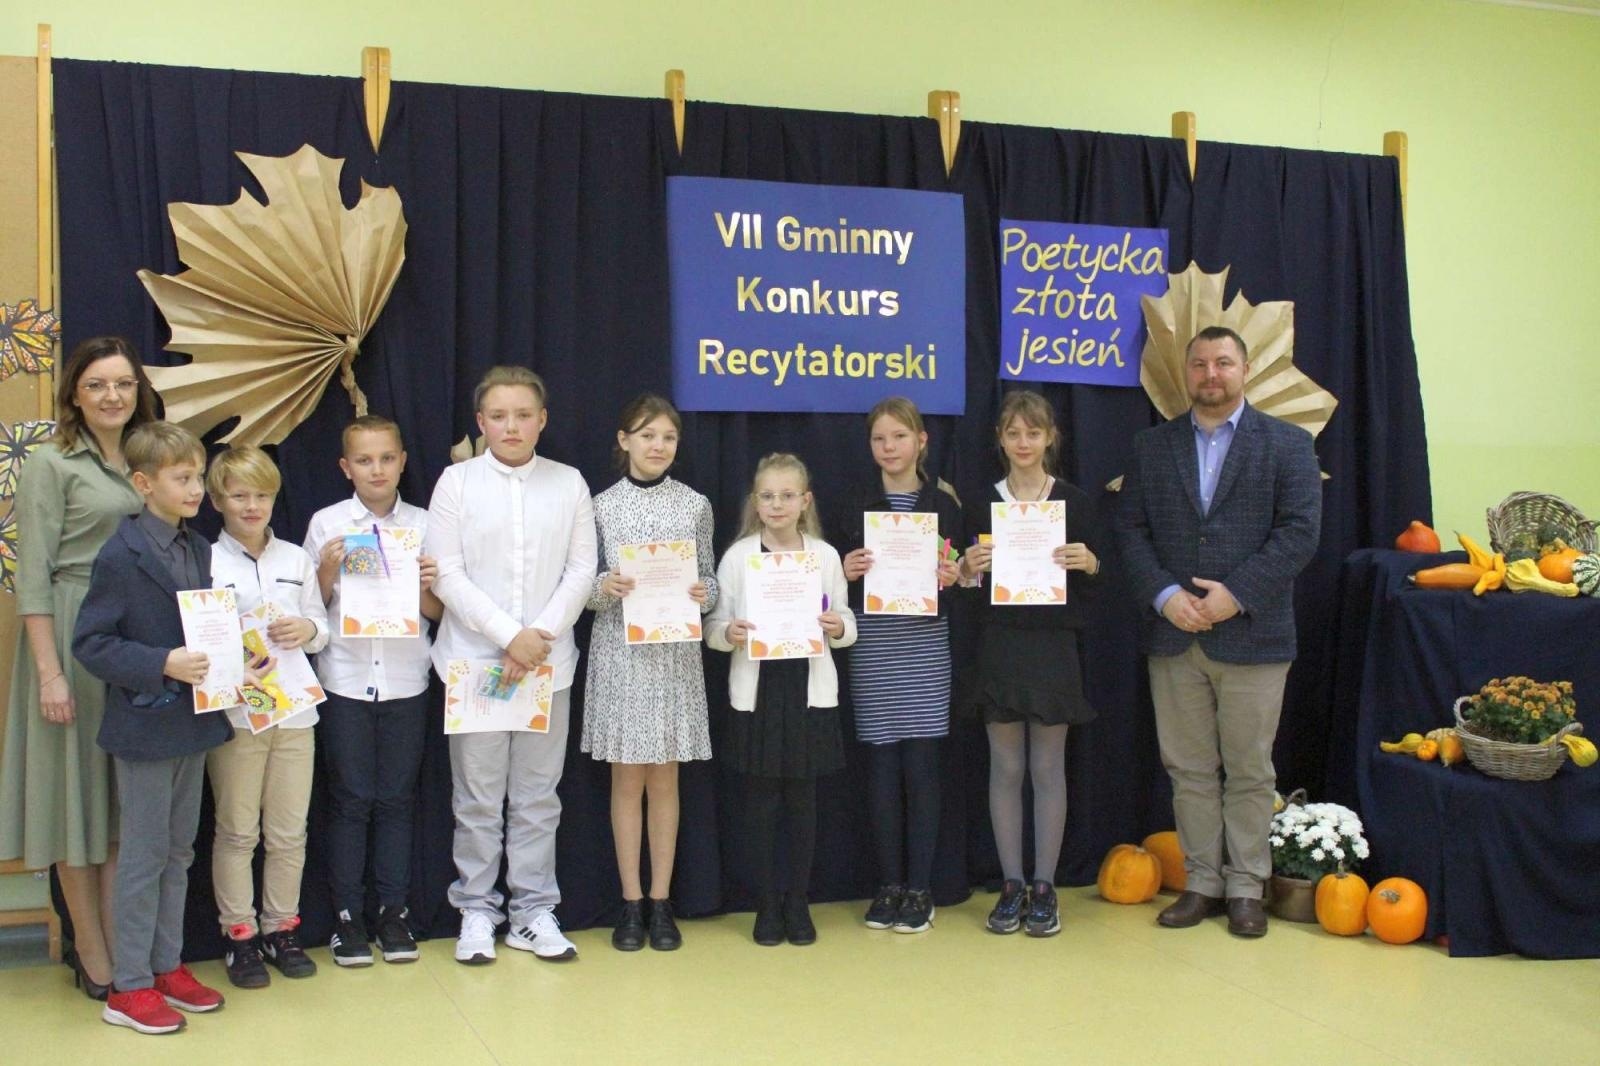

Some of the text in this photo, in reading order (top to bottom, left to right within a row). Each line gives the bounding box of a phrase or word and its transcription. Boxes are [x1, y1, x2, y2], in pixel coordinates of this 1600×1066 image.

[714, 211, 914, 266] VII Gminny
[1002, 227, 1166, 284] Poetycka
[736, 276, 899, 317] Konkurs
[1011, 274, 1119, 321] złota
[698, 338, 937, 386] Recytatorski
[1006, 326, 1125, 376] jesień
